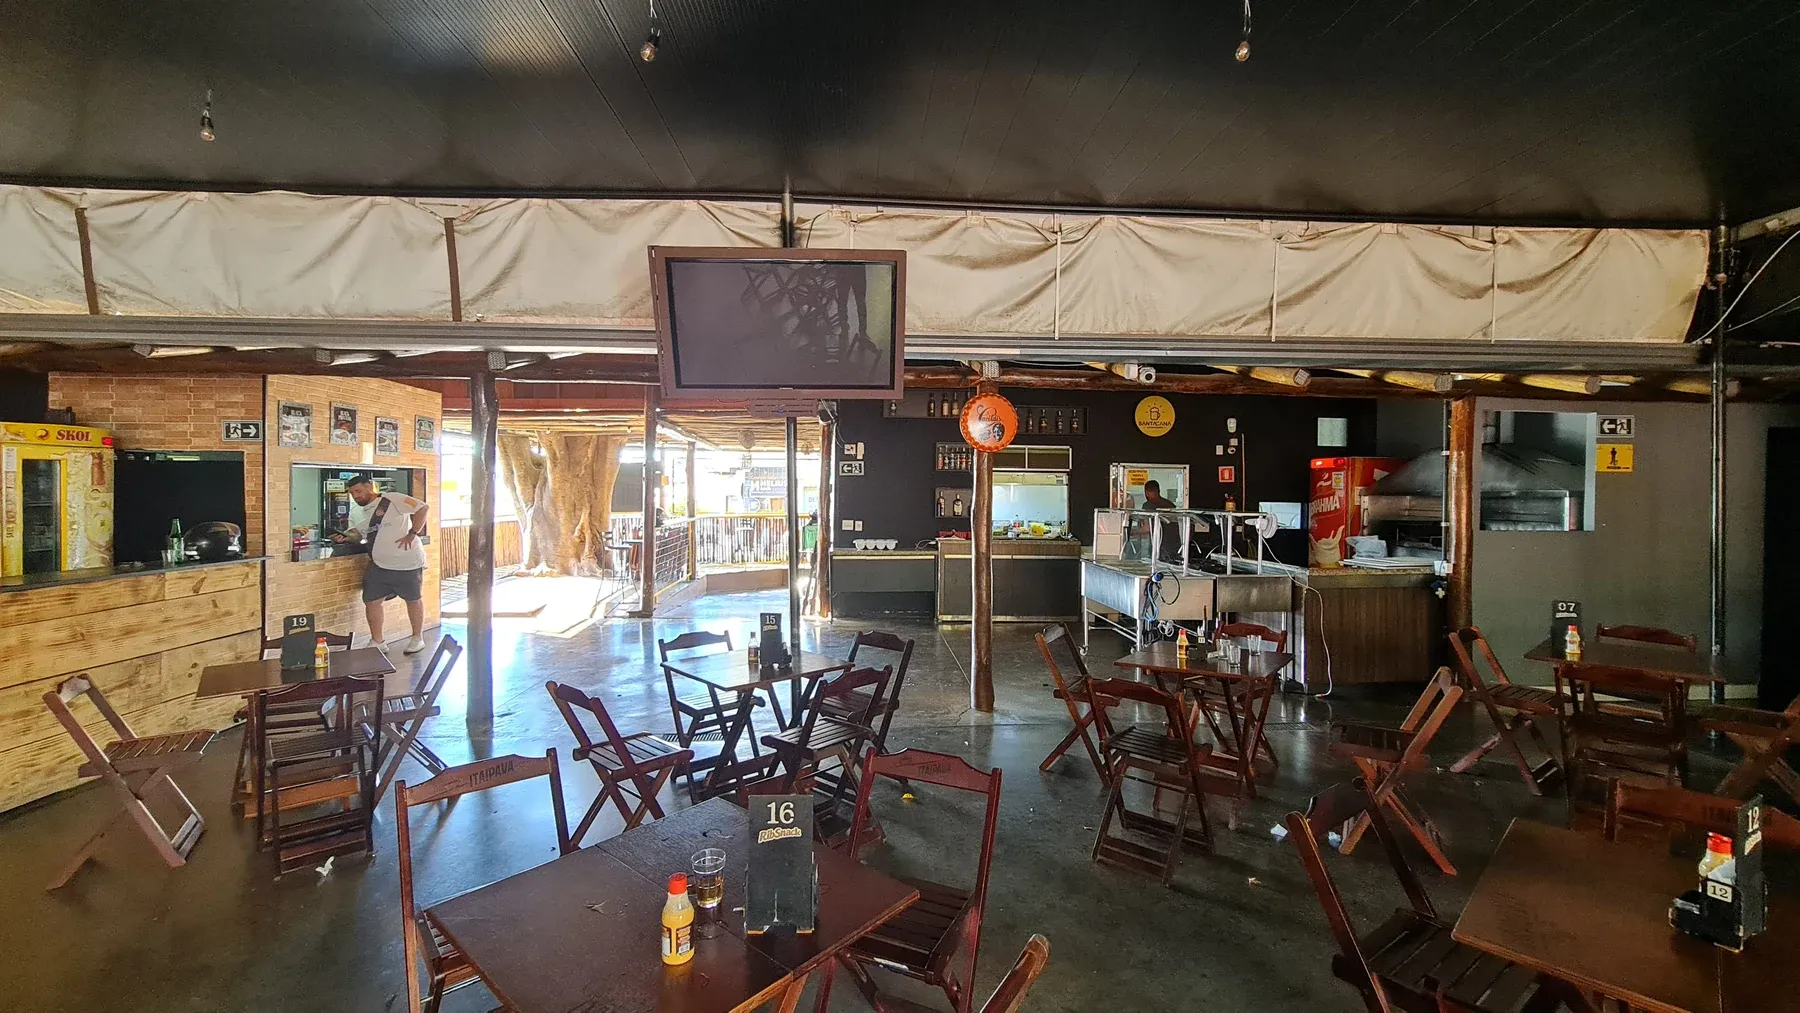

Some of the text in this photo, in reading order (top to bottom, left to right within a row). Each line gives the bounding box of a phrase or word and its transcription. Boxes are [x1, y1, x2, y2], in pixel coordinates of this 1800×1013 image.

[56, 429, 92, 442] SKOL
[1558, 602, 1576, 612] 07
[292, 616, 307, 627] 19
[765, 614, 776, 625] 15
[469, 760, 516, 788] ITAIPAVA
[767, 801, 795, 825] 16
[1747, 806, 1760, 833] 12
[759, 827, 801, 843] RibSnack
[1710, 884, 1729, 899] 12
